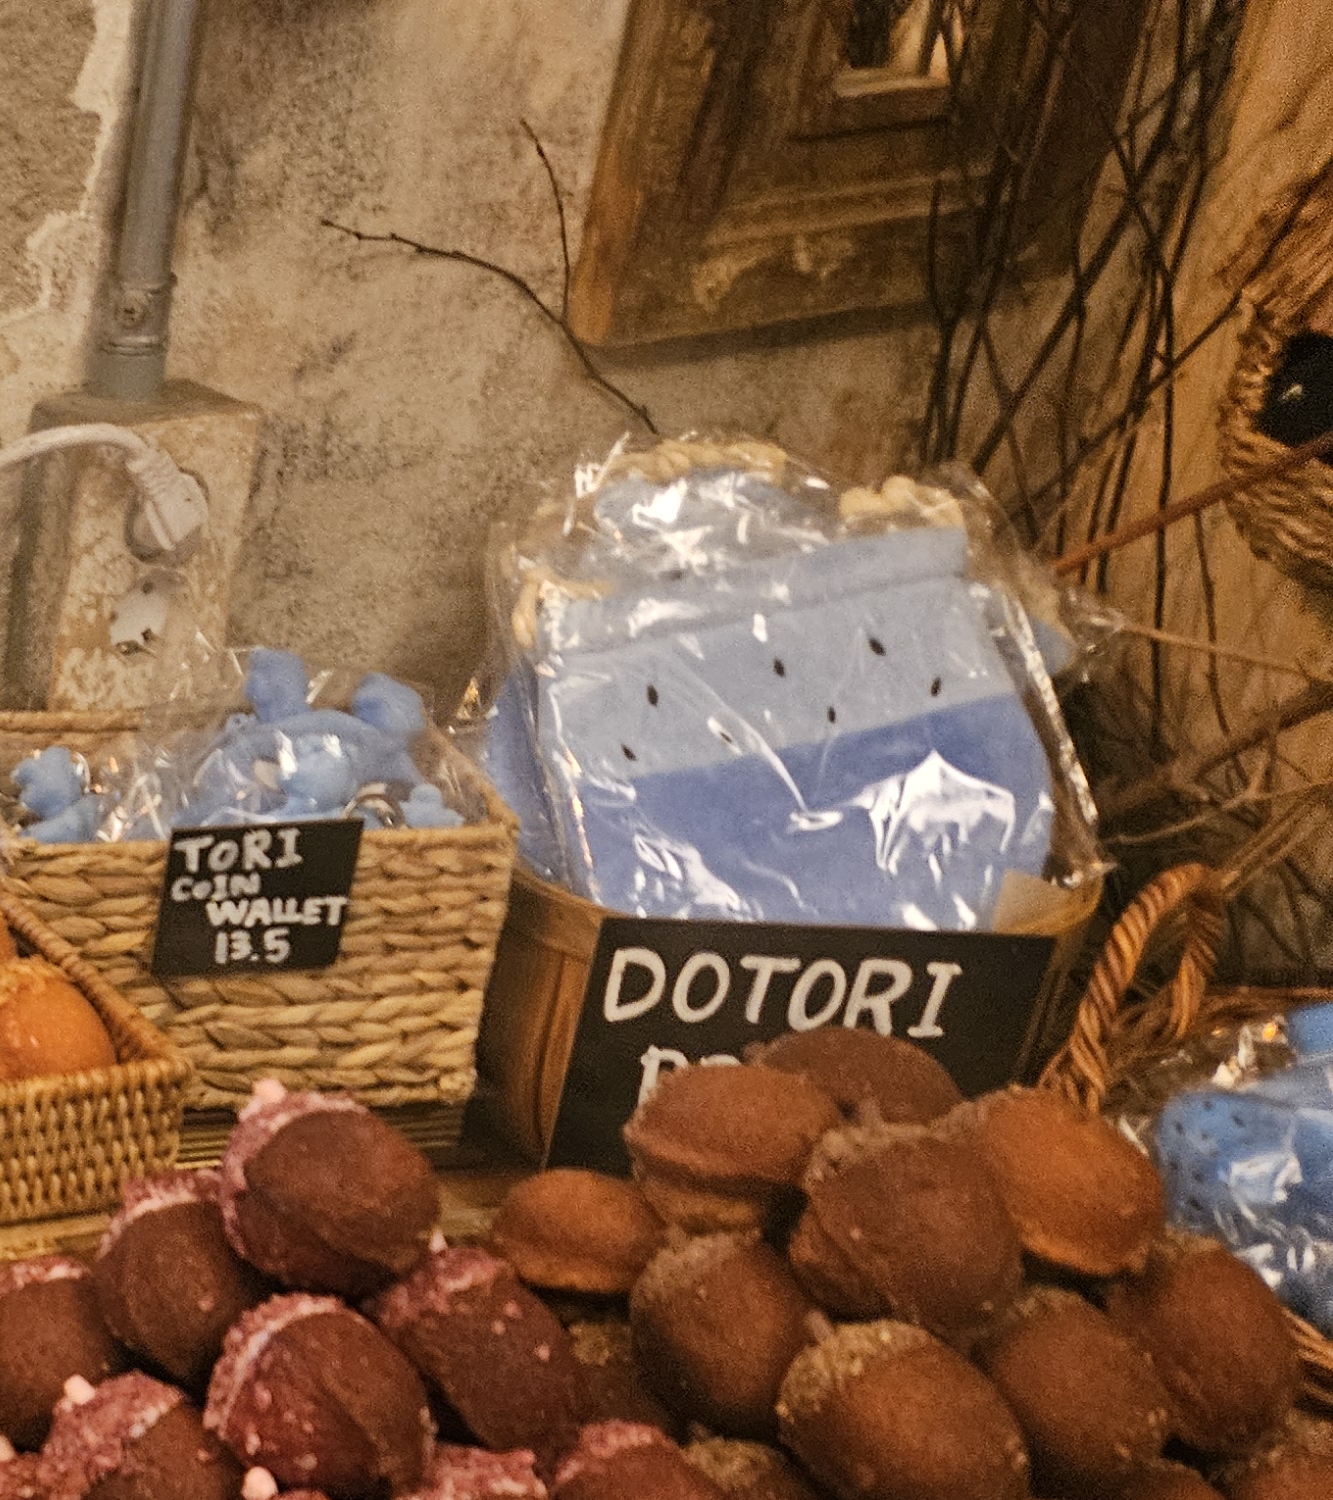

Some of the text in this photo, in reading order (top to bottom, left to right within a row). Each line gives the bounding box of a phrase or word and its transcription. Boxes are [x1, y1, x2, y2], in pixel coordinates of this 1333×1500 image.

[173, 827, 303, 873] TORI
[171, 871, 261, 902] COIN
[205, 896, 349, 928] WALLET
[214, 927, 291, 965] 13.5
[603, 946, 963, 1039] DOTORI
